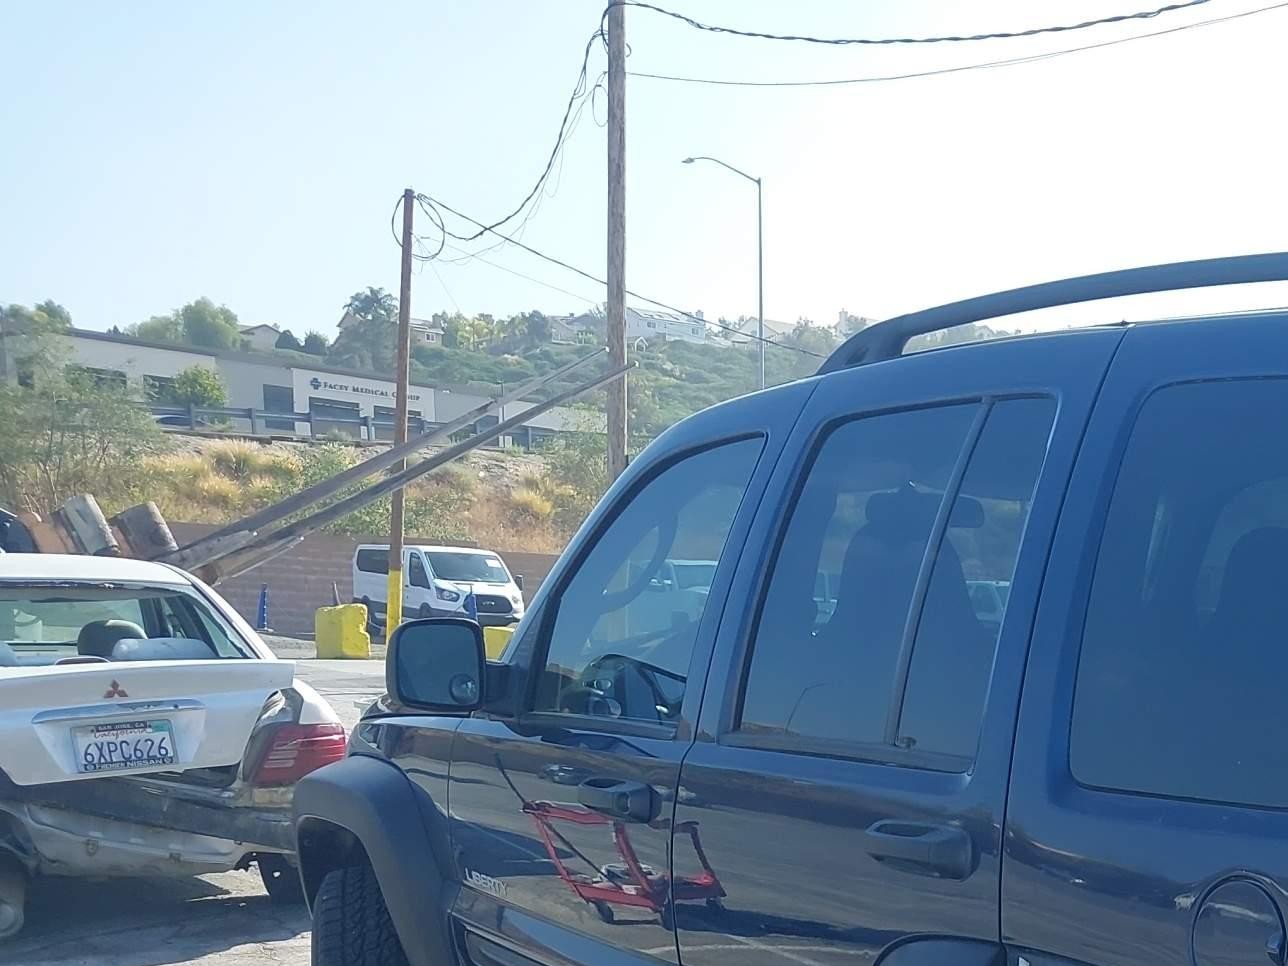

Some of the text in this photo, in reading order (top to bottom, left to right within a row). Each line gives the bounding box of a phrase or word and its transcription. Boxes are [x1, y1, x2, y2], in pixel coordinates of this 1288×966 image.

[323, 382, 349, 392] FACEY
[352, 386, 389, 397] MEDICAL
[84, 737, 168, 763] 6XPC626
